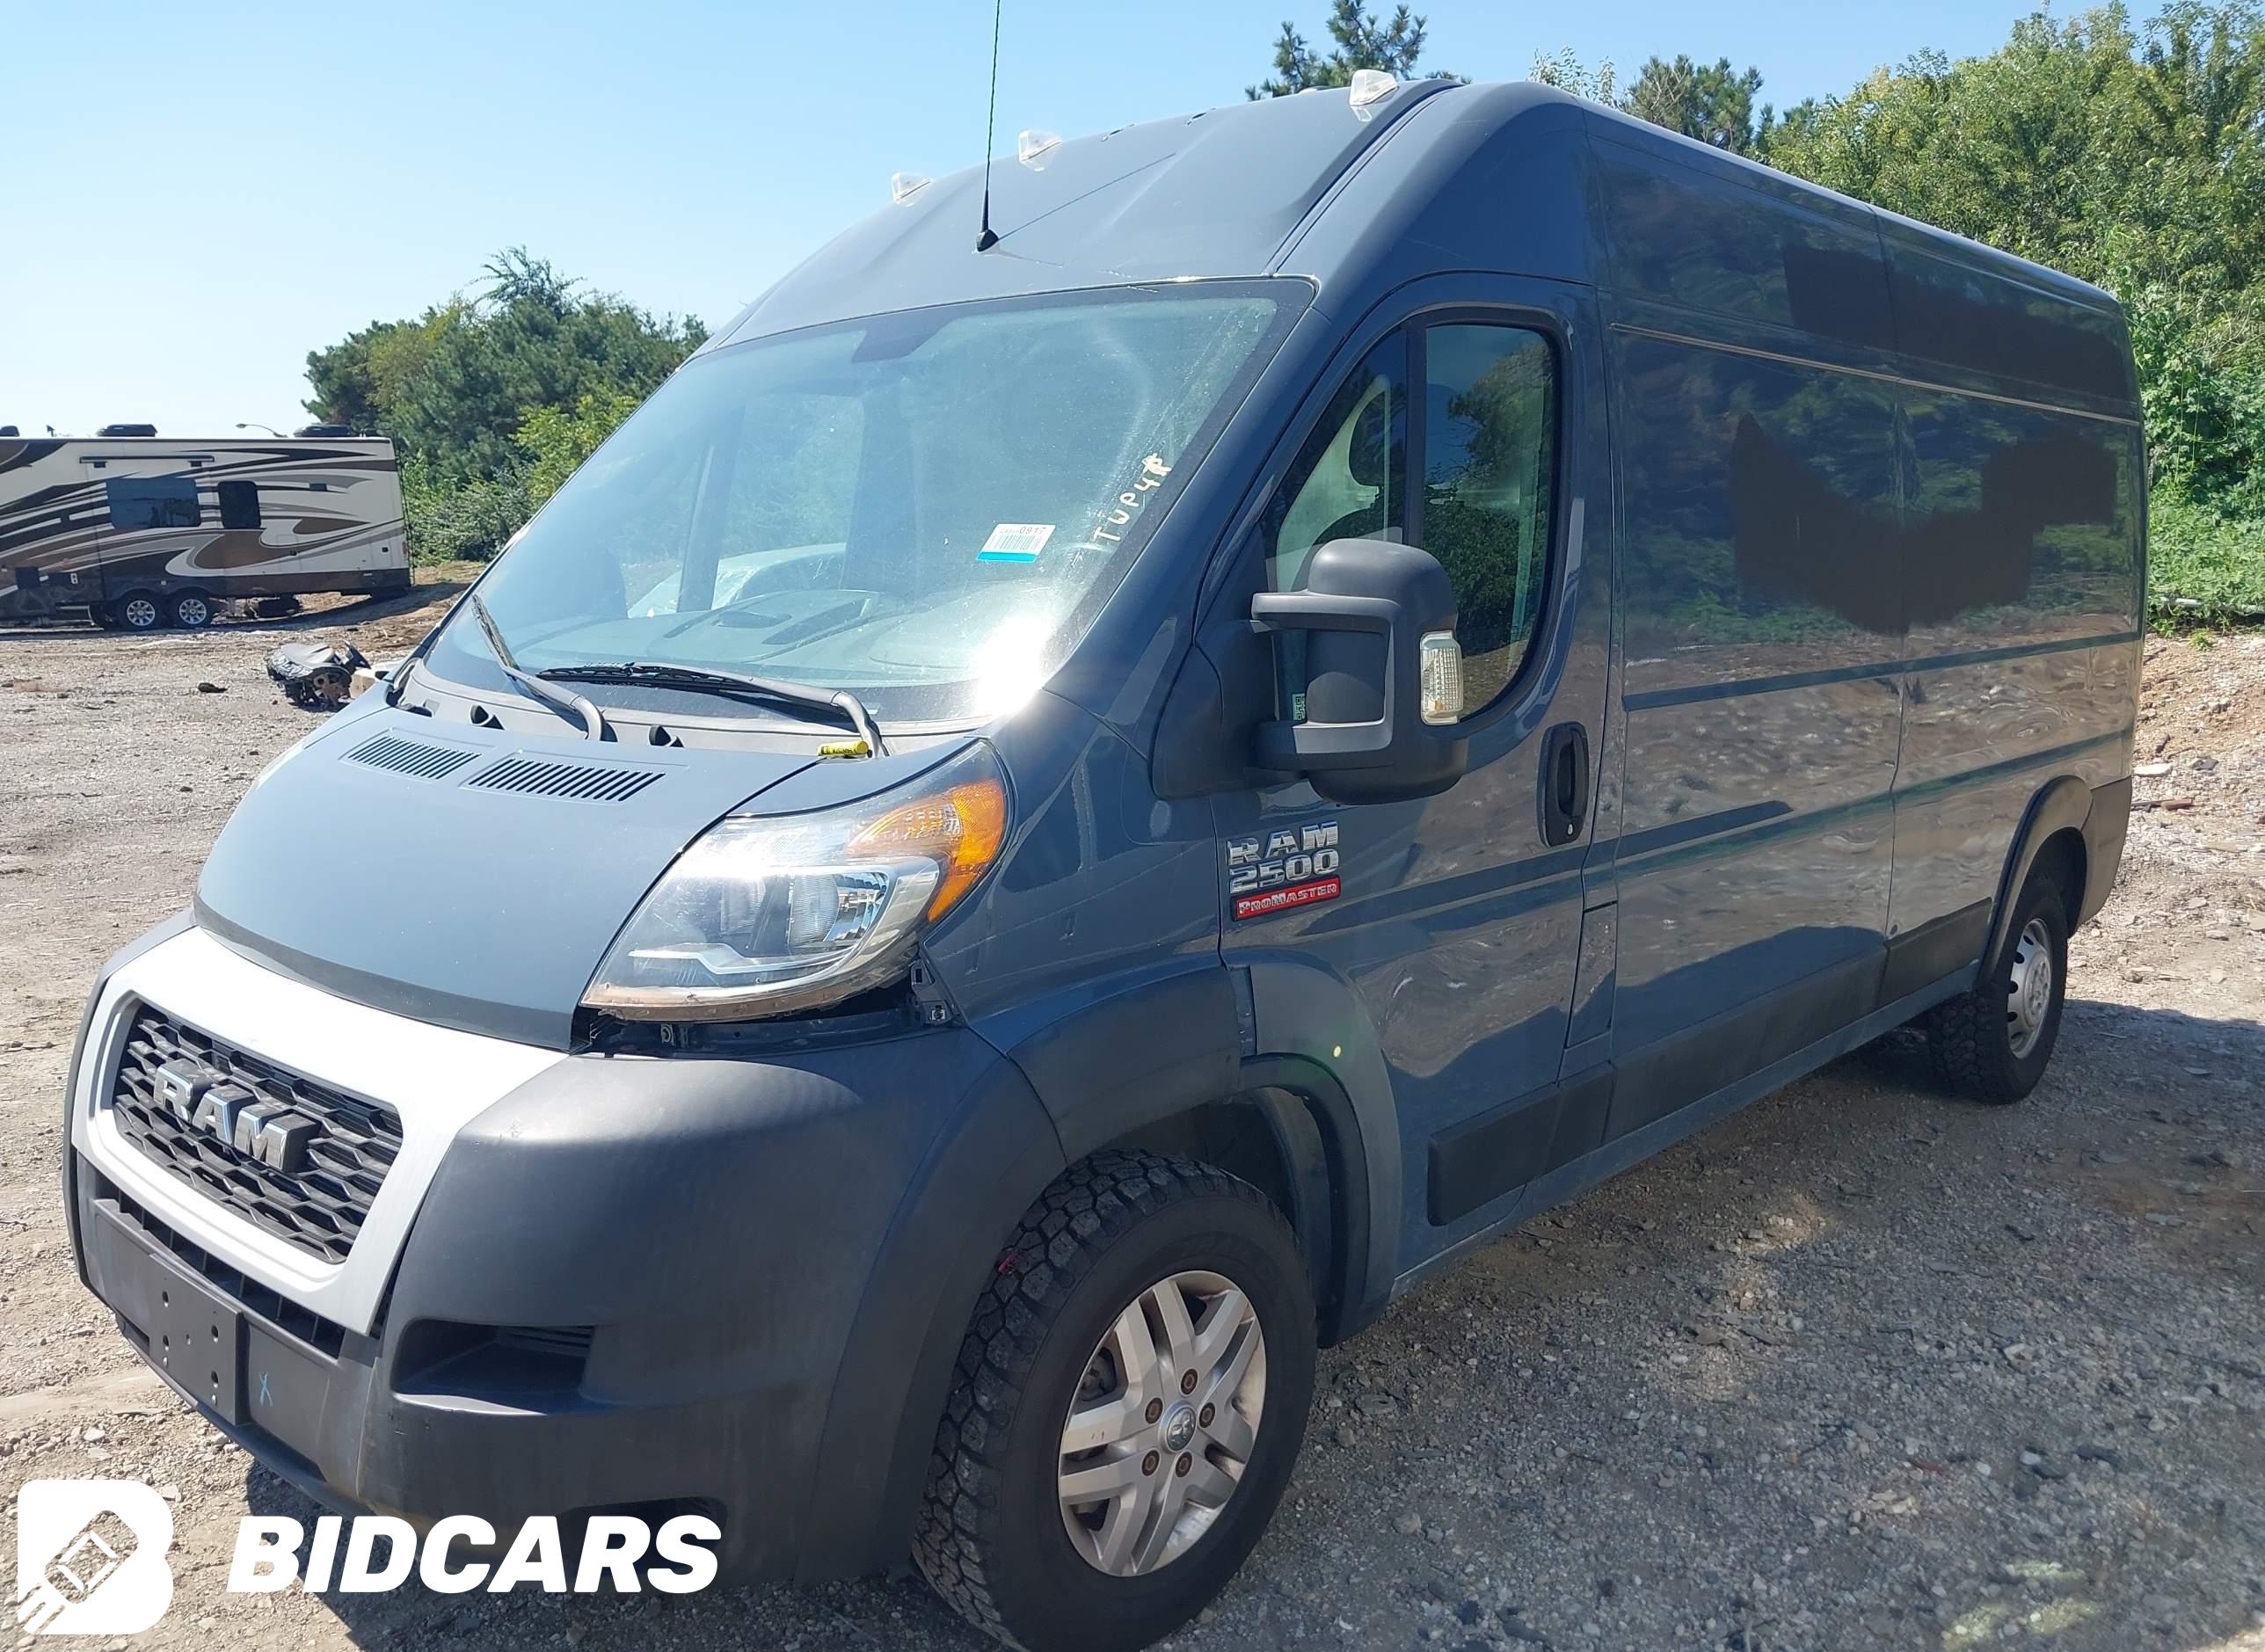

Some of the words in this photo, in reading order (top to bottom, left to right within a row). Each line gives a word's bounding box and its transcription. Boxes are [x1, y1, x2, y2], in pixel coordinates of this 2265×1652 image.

[1227, 820, 1338, 866] RAM
[1229, 848, 1339, 894] 2500
[153, 1060, 303, 1172] RAM
